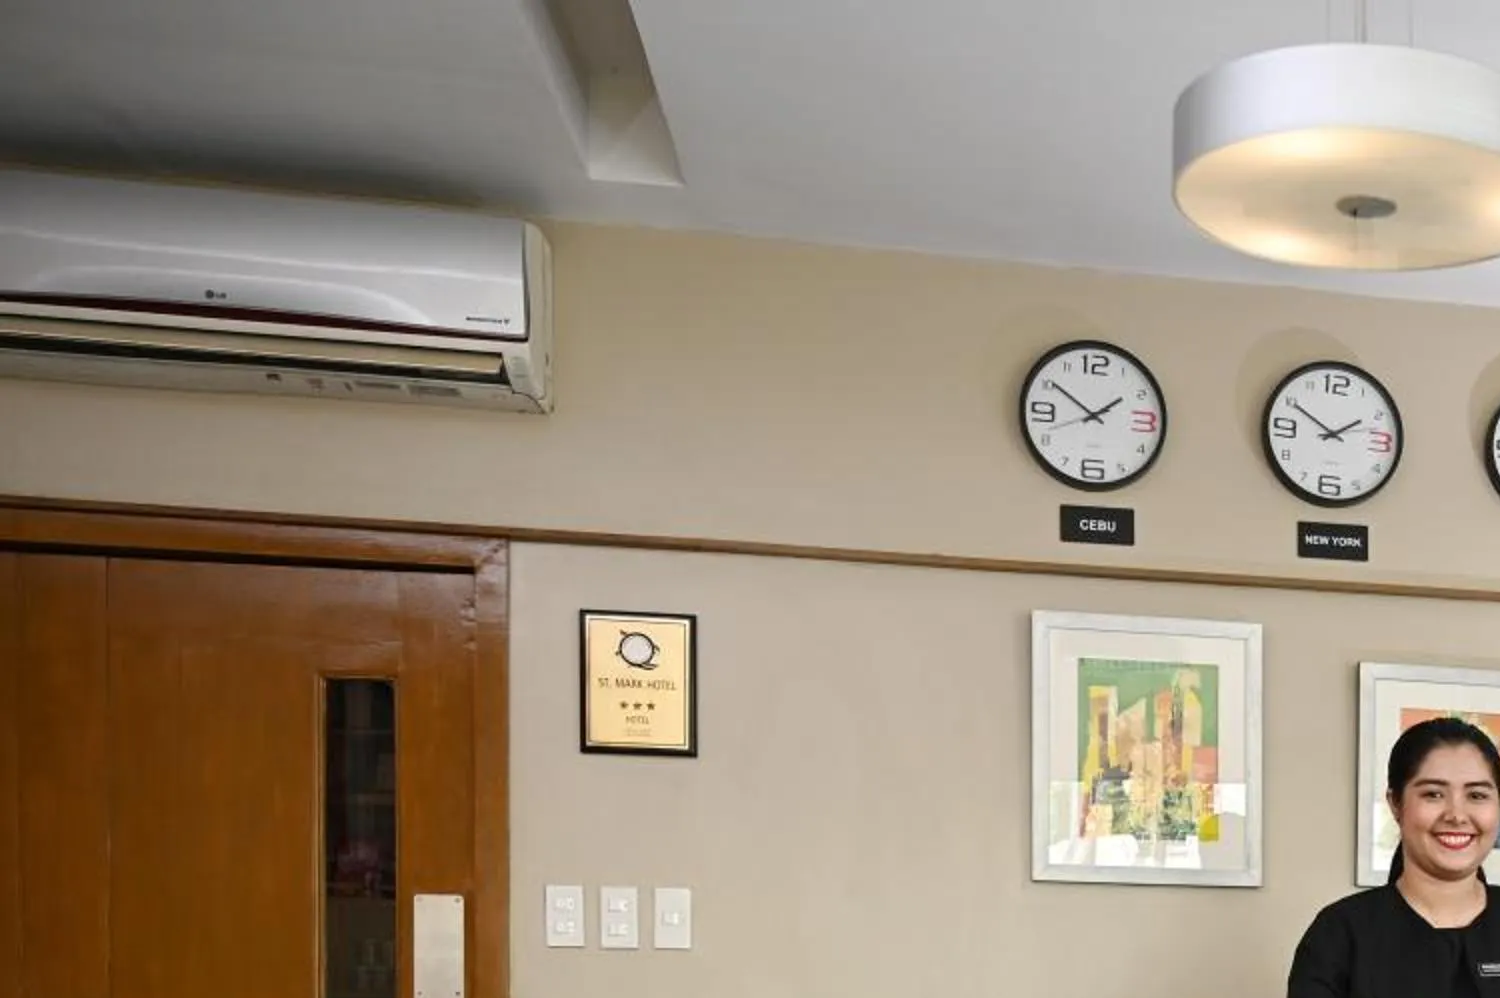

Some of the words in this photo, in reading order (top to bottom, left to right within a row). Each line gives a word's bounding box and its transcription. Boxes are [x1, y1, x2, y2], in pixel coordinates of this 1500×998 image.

[1081, 353, 1110, 376] 12
[1324, 373, 1351, 397] 12
[1031, 401, 1056, 423] 9
[1130, 410, 1157, 433] 3
[1273, 417, 1297, 438] 9
[1367, 431, 1393, 453] 3
[1080, 459, 1105, 480] 6
[1318, 474, 1341, 496] 6
[1079, 518, 1118, 533] CEBU
[1305, 535, 1329, 546] NEW
[1331, 536, 1361, 547] YORK
[598, 677, 612, 688] ST.
[615, 677, 643, 689] MARK
[647, 679, 677, 691] HOTEL
